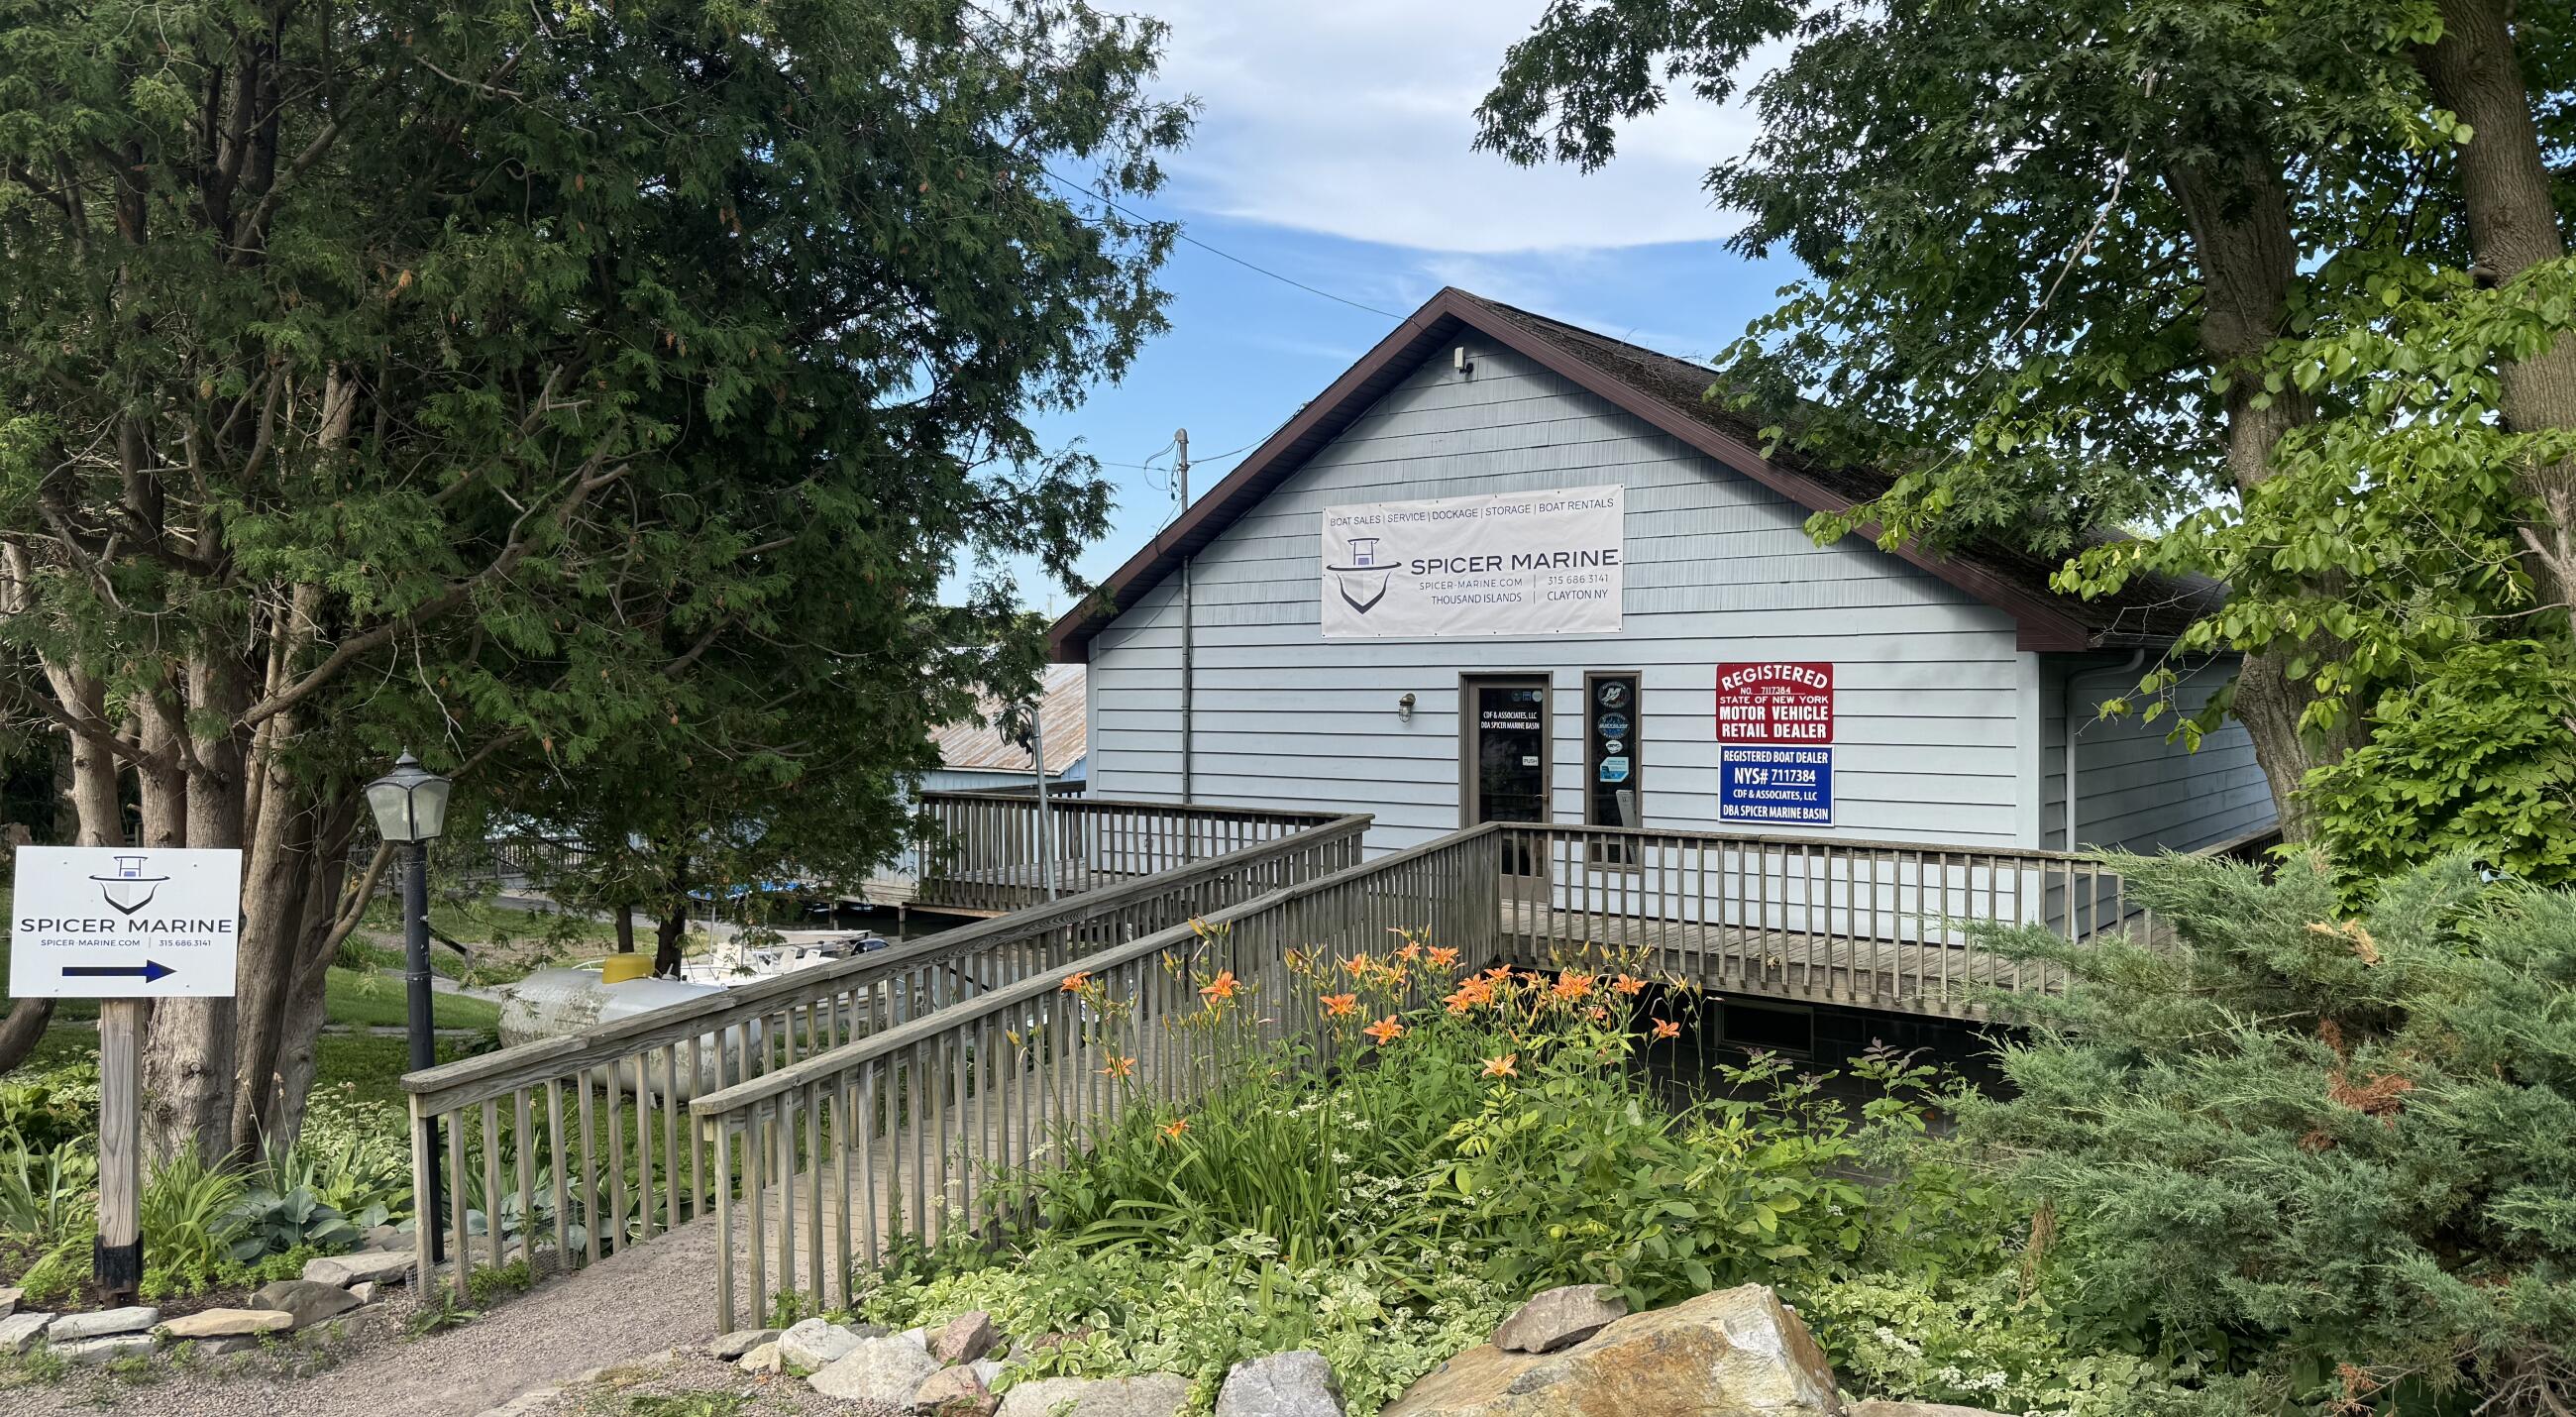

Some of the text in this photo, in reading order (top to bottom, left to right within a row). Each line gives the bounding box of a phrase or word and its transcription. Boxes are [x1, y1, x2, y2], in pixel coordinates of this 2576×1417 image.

[1330, 498, 1614, 527] BOAT SALES SERVICE DOCKAGE STORAGE BOAT RENTALS
[1411, 549, 1619, 575] SPICER MARINE
[1419, 578, 1523, 591] SPICER-MARINE.COM
[1432, 589, 1608, 605] THOUSAND ISLANDS CLAYTON NY
[1721, 665, 1828, 691] REGISTERED
[1719, 696, 1828, 704] STATE OF NEW YORK
[1498, 711, 1528, 719] ASSOCIATES,
[1719, 706, 1828, 720] MOTOR VEHICLE
[1722, 723, 1826, 738] RETAIL DEALER
[1724, 750, 1828, 763] REGISTERED BOAT DEALER
[1734, 767, 1816, 785] NYS# 7117384
[1733, 789, 1817, 802] CDF & ASSOCIATES, LLC
[1723, 805, 1828, 820] DBA SPICER MARINE BASIN
[20, 918, 232, 933] SPICER MARINE
